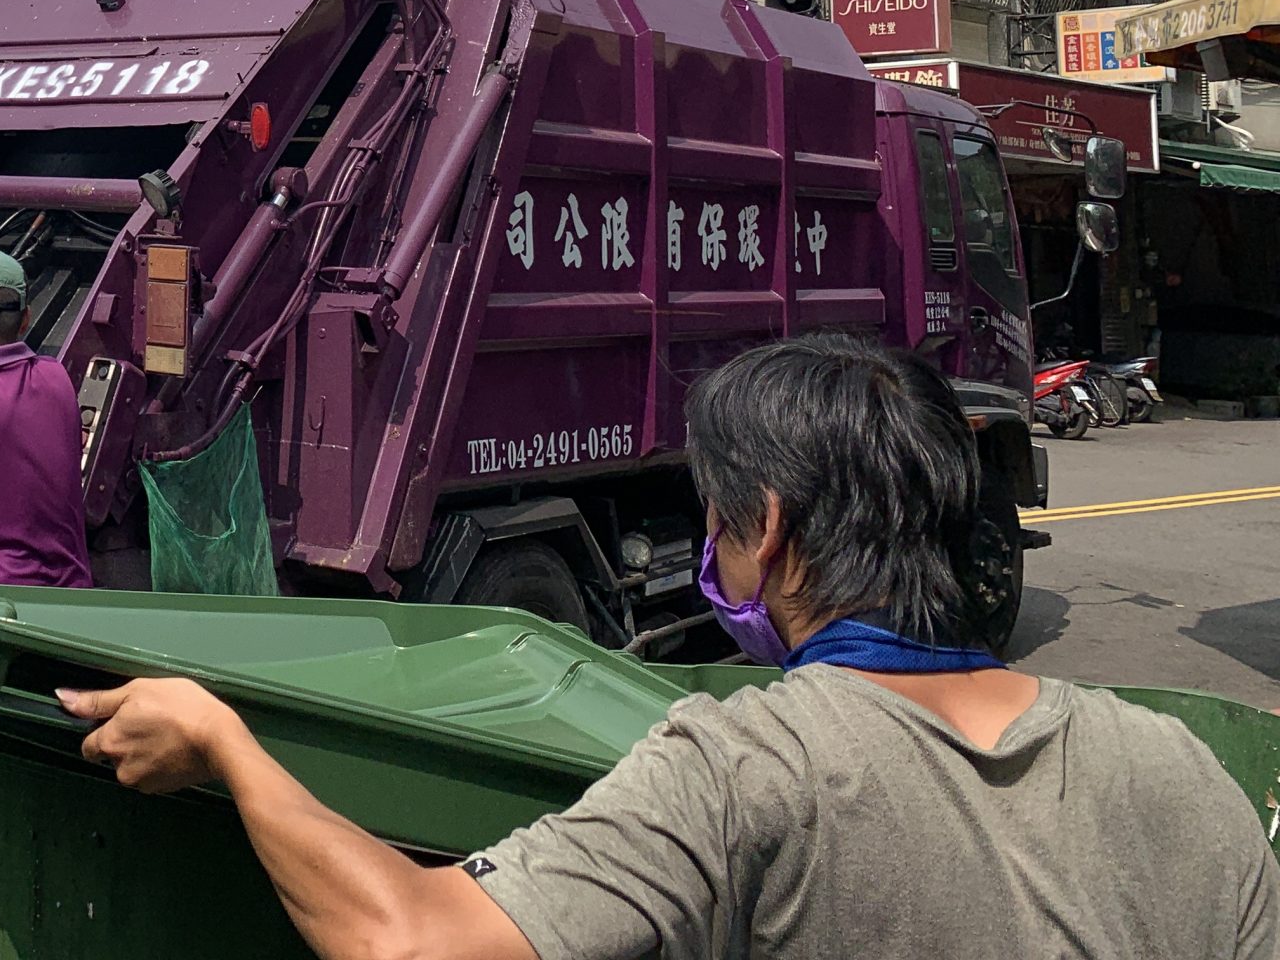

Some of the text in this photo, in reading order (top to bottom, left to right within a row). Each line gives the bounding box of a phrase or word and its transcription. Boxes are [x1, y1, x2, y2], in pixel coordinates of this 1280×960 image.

[868, 22, 896, 36] 資生堂
[1045, 95, 1076, 126] 佳芳
